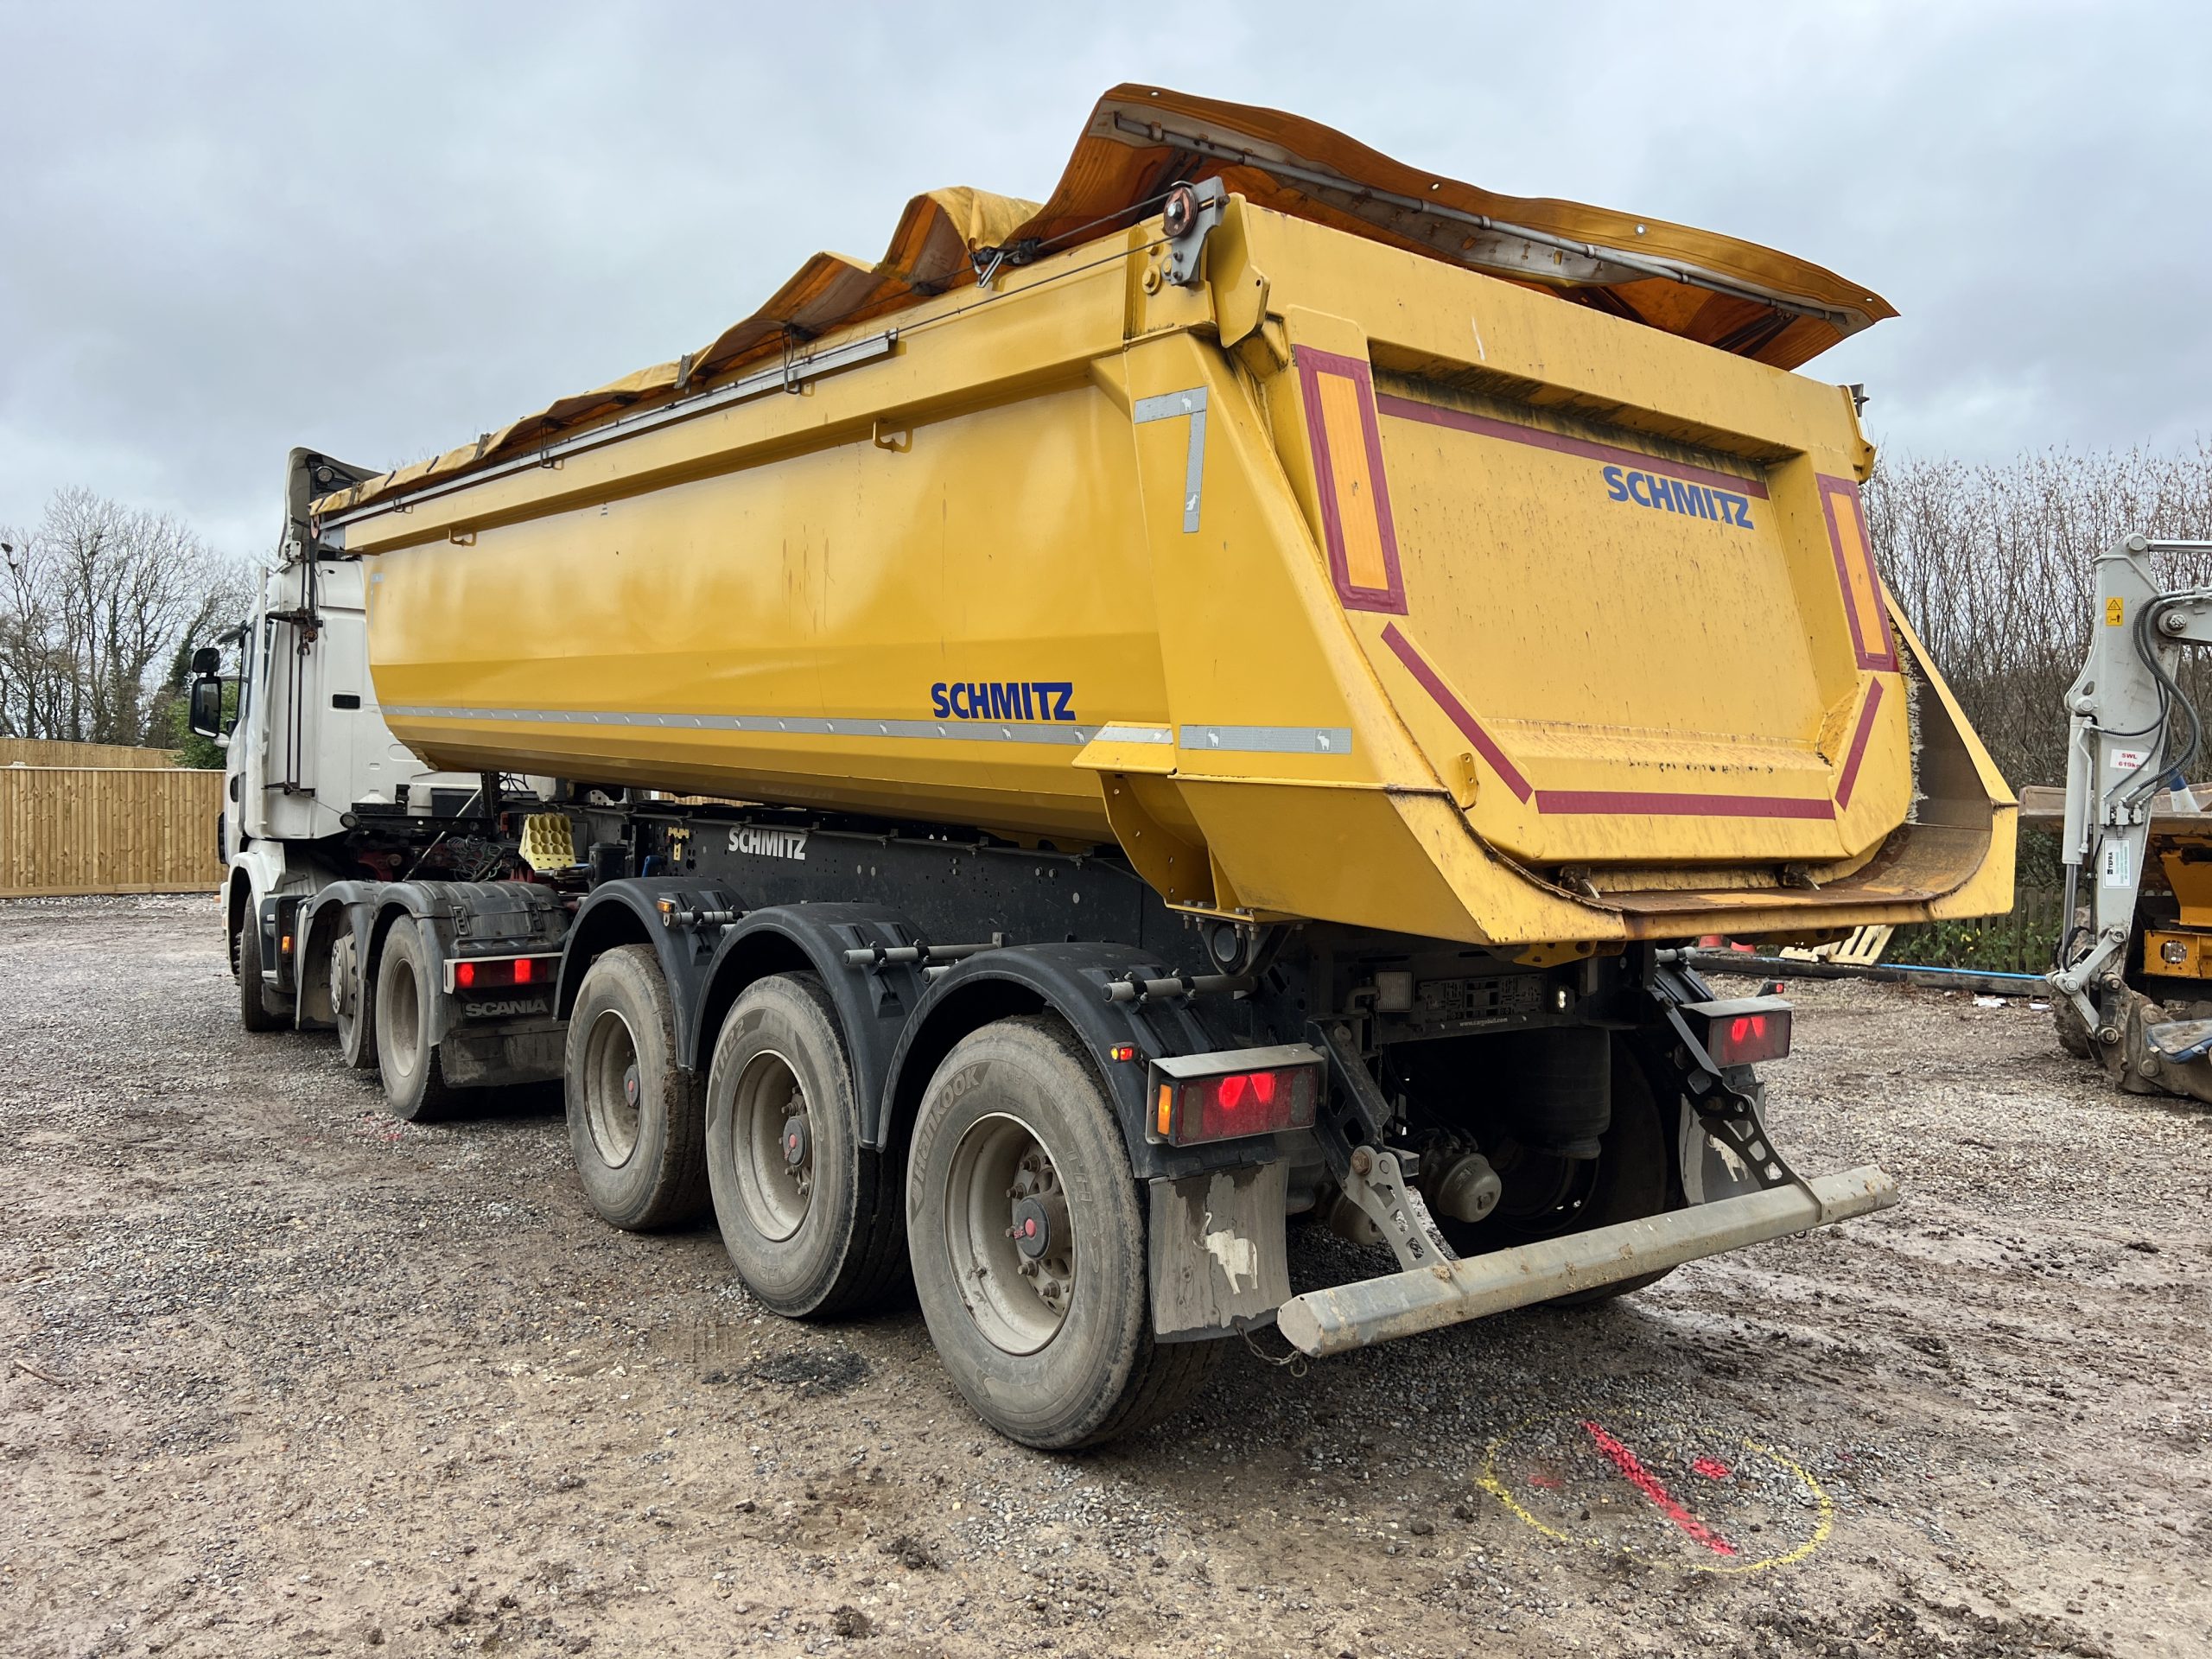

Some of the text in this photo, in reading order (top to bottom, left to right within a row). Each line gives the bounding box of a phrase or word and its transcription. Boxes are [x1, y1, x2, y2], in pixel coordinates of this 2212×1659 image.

[1603, 466, 1754, 530] SCHMITZ
[931, 682, 1077, 721] SCHMITZ
[728, 826, 809, 861] SCHMITZ
[465, 999, 549, 1017] SCANIA
[713, 1019, 745, 1083] TH22
